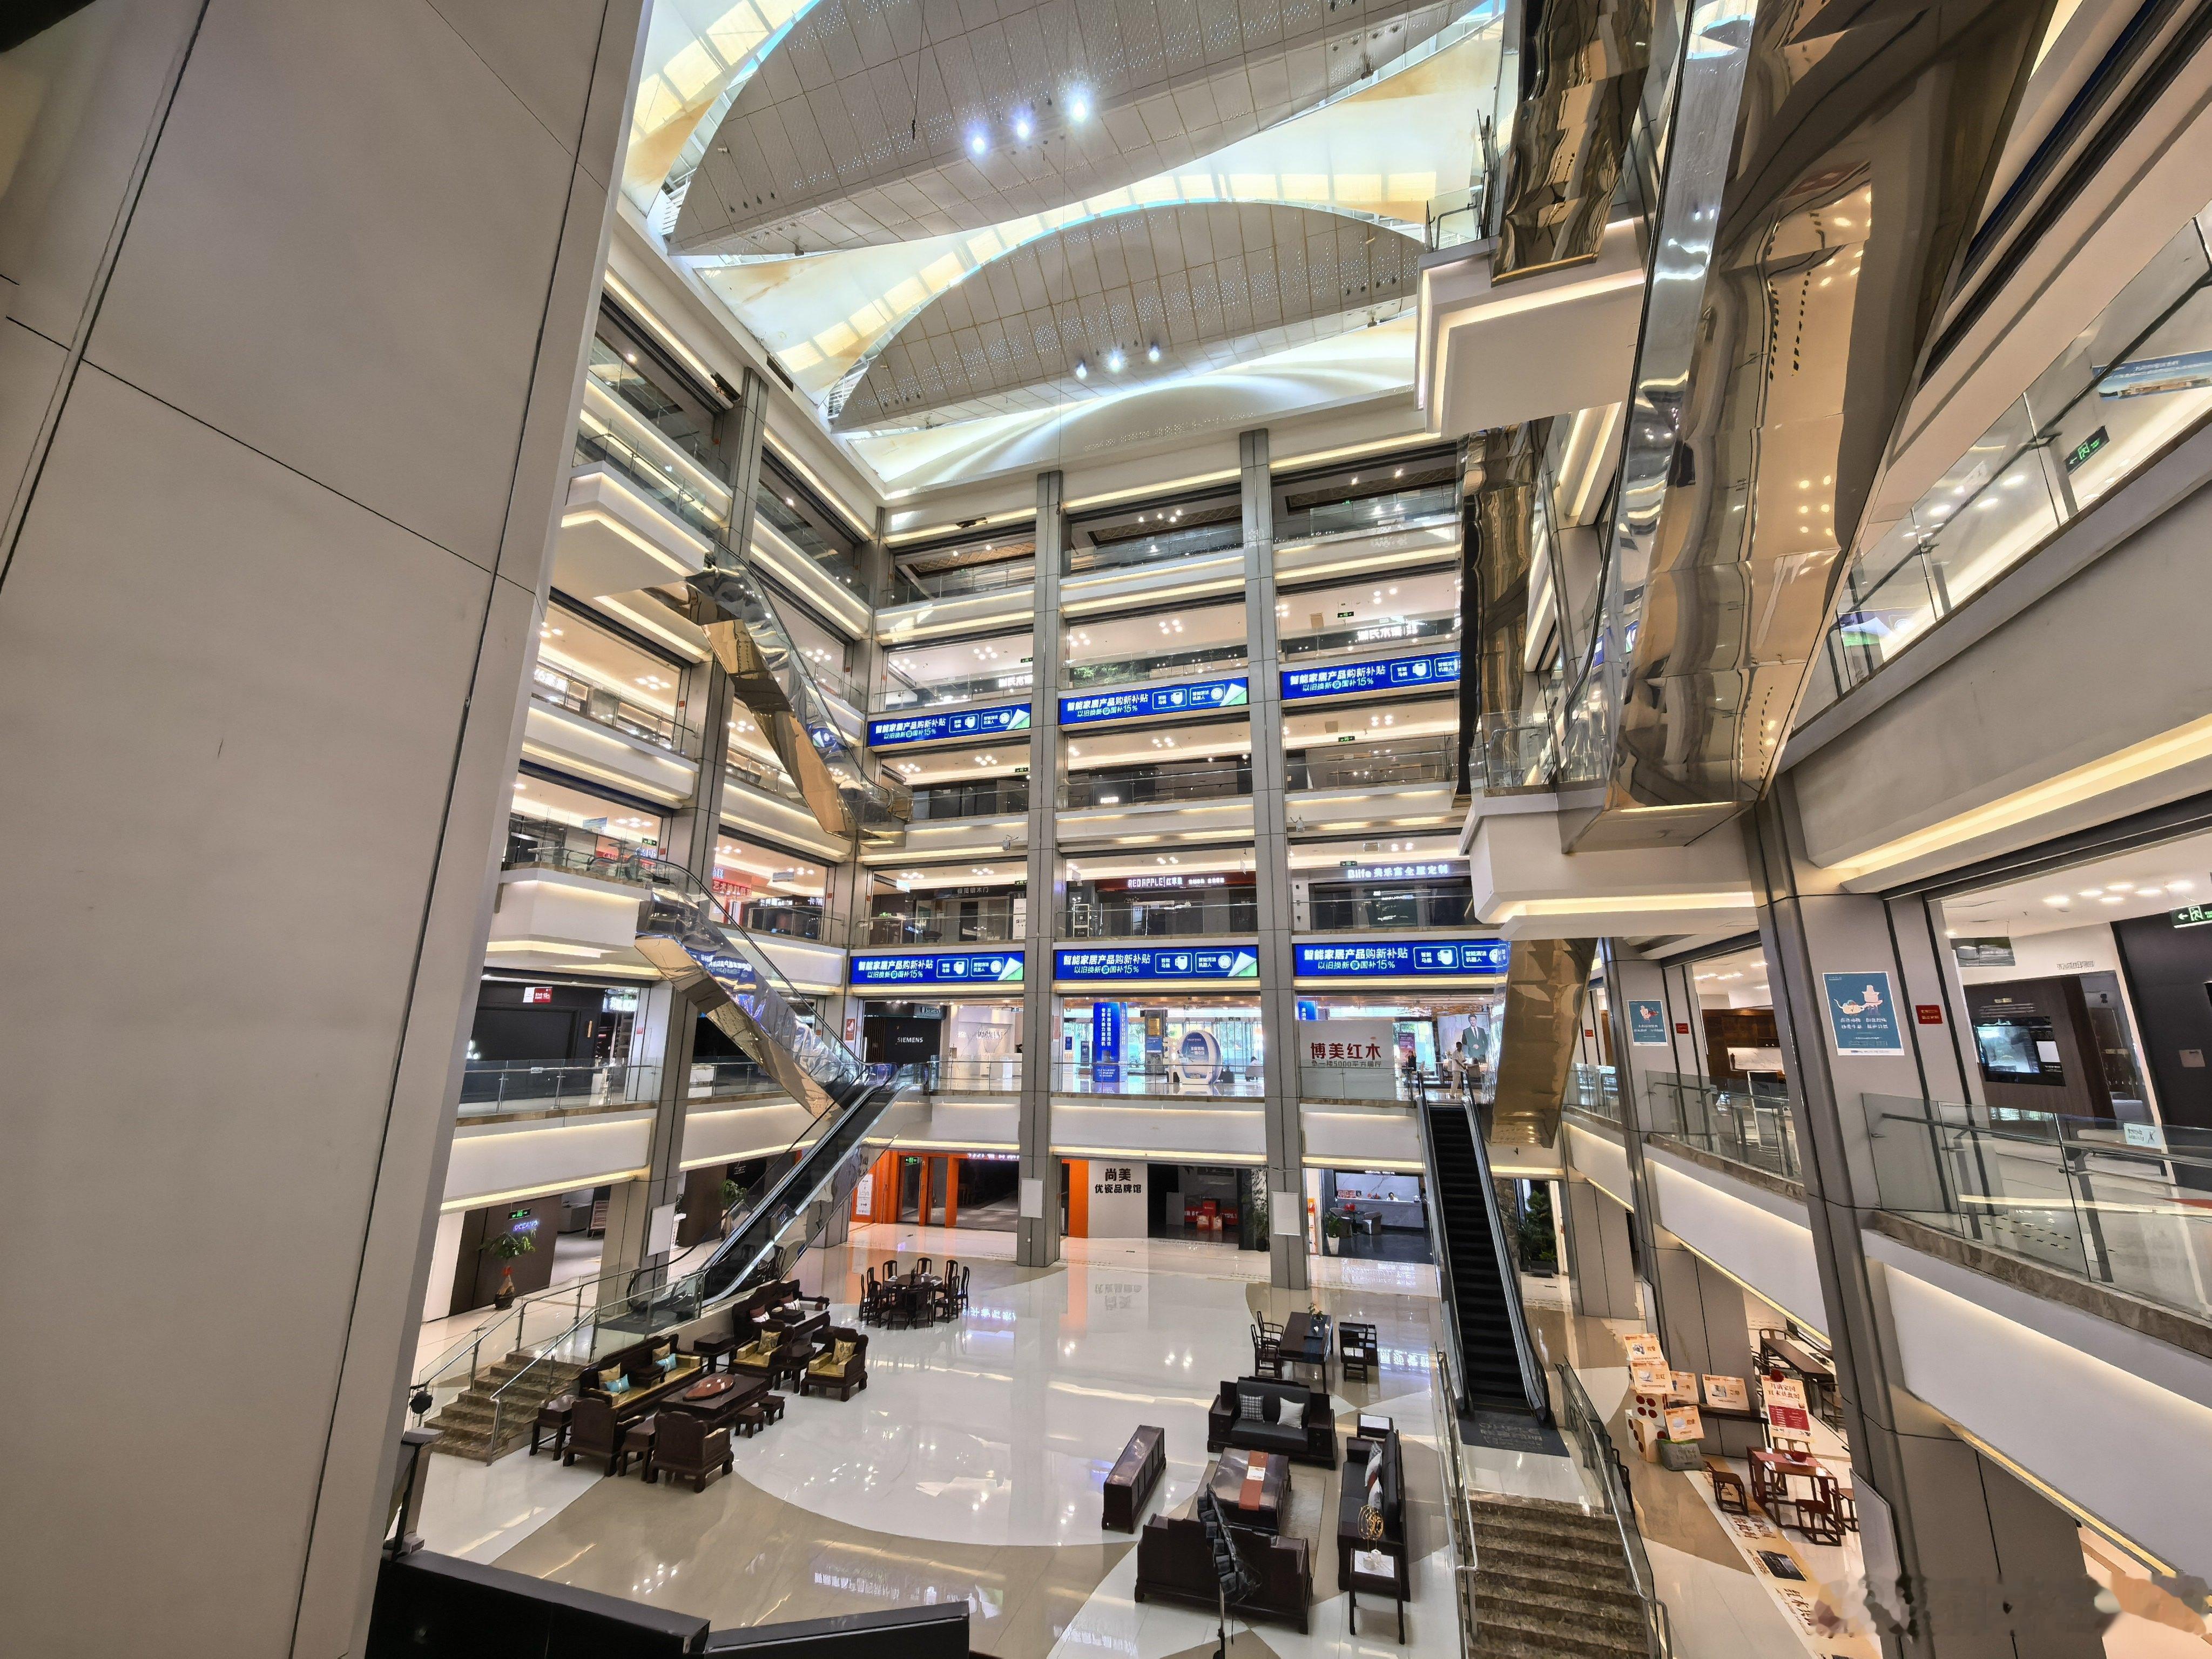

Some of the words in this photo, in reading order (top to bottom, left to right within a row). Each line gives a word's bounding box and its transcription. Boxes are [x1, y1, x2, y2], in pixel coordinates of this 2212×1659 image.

[1290, 664, 1386, 686] 智能家居产品购新补贴
[1067, 694, 1149, 712] 智能家居产品购新补贴
[1063, 954, 1151, 966] 智能家居产品购新补贴
[1304, 948, 1408, 961] 智能家居产品购新补贴
[858, 959, 933, 971] 智能家居产品购新补贴
[1311, 1042, 1382, 1061] 博美红木
[1105, 1168, 1131, 1182] 尚美
[1095, 1184, 1142, 1193] 优瓷品牌馆
